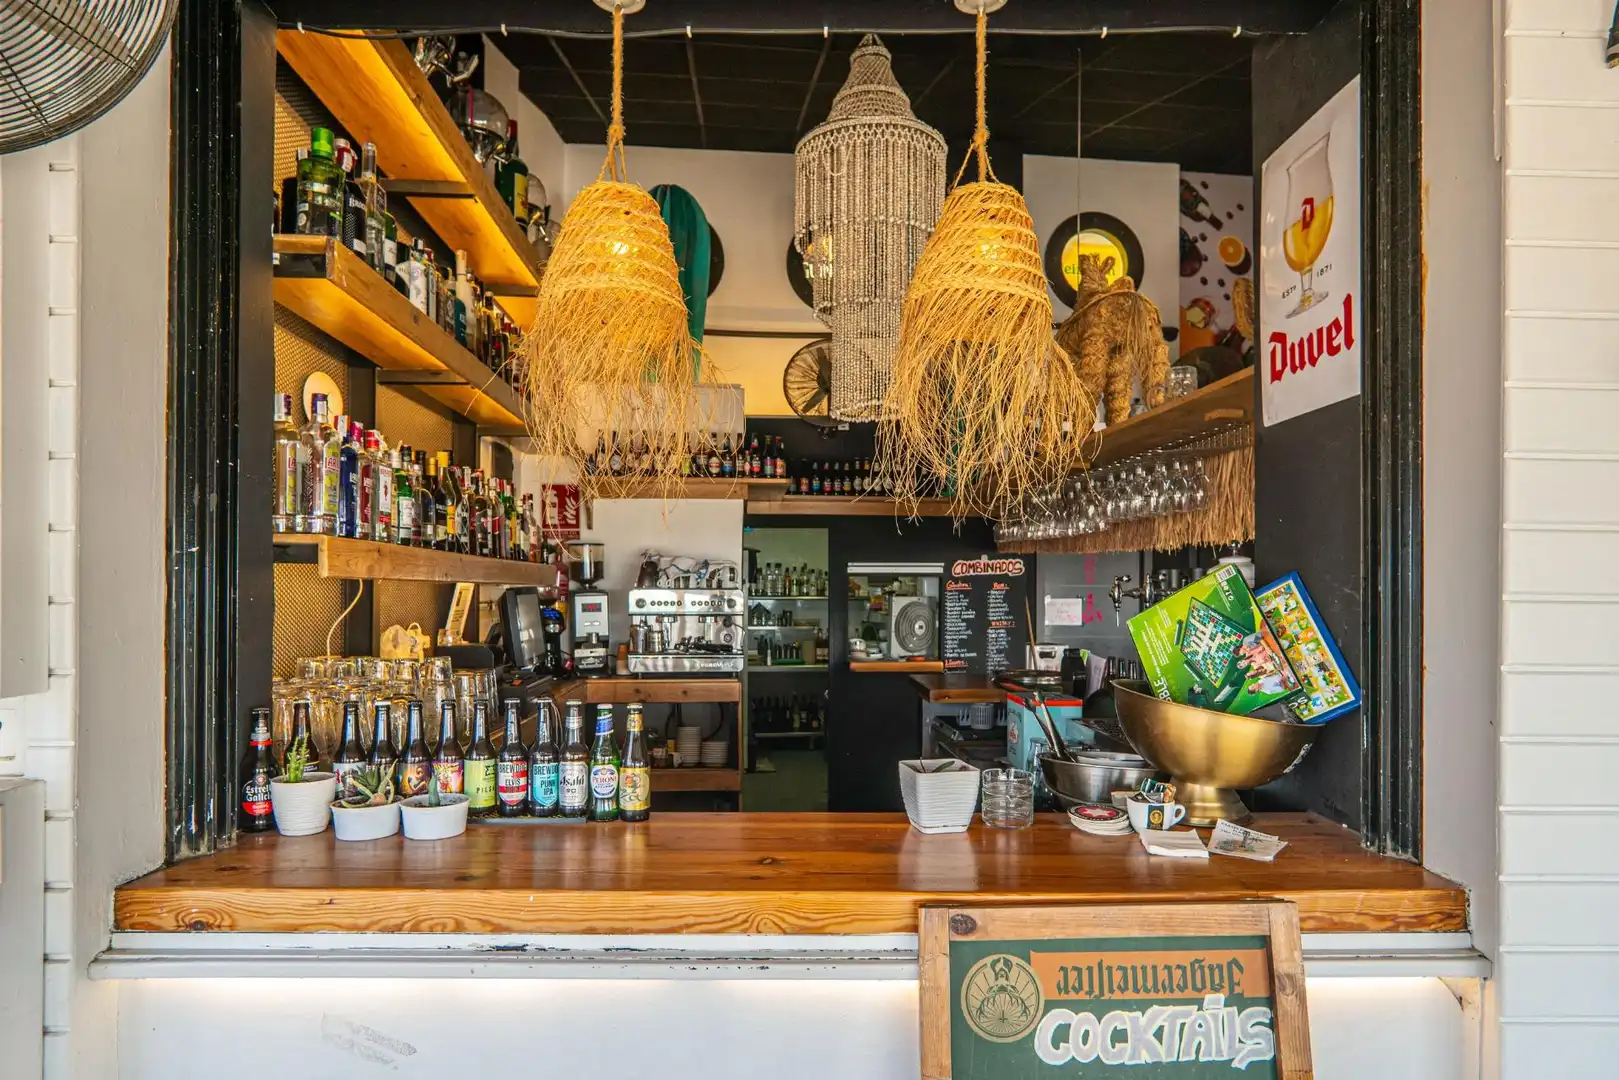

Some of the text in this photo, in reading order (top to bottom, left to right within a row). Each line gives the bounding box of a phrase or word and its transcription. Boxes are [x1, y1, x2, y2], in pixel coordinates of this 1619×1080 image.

[1316, 263, 1333, 278] 1871
[1268, 292, 1355, 385] Duvel
[534, 763, 559, 776] BREWDO
[504, 778, 521, 787] ELVIS
[559, 775, 585, 787] Asahi
[592, 776, 617, 784] PERONI
[245, 784, 269, 793] Estrel
[543, 787, 554, 796] IPA
[246, 793, 270, 802] Galici
